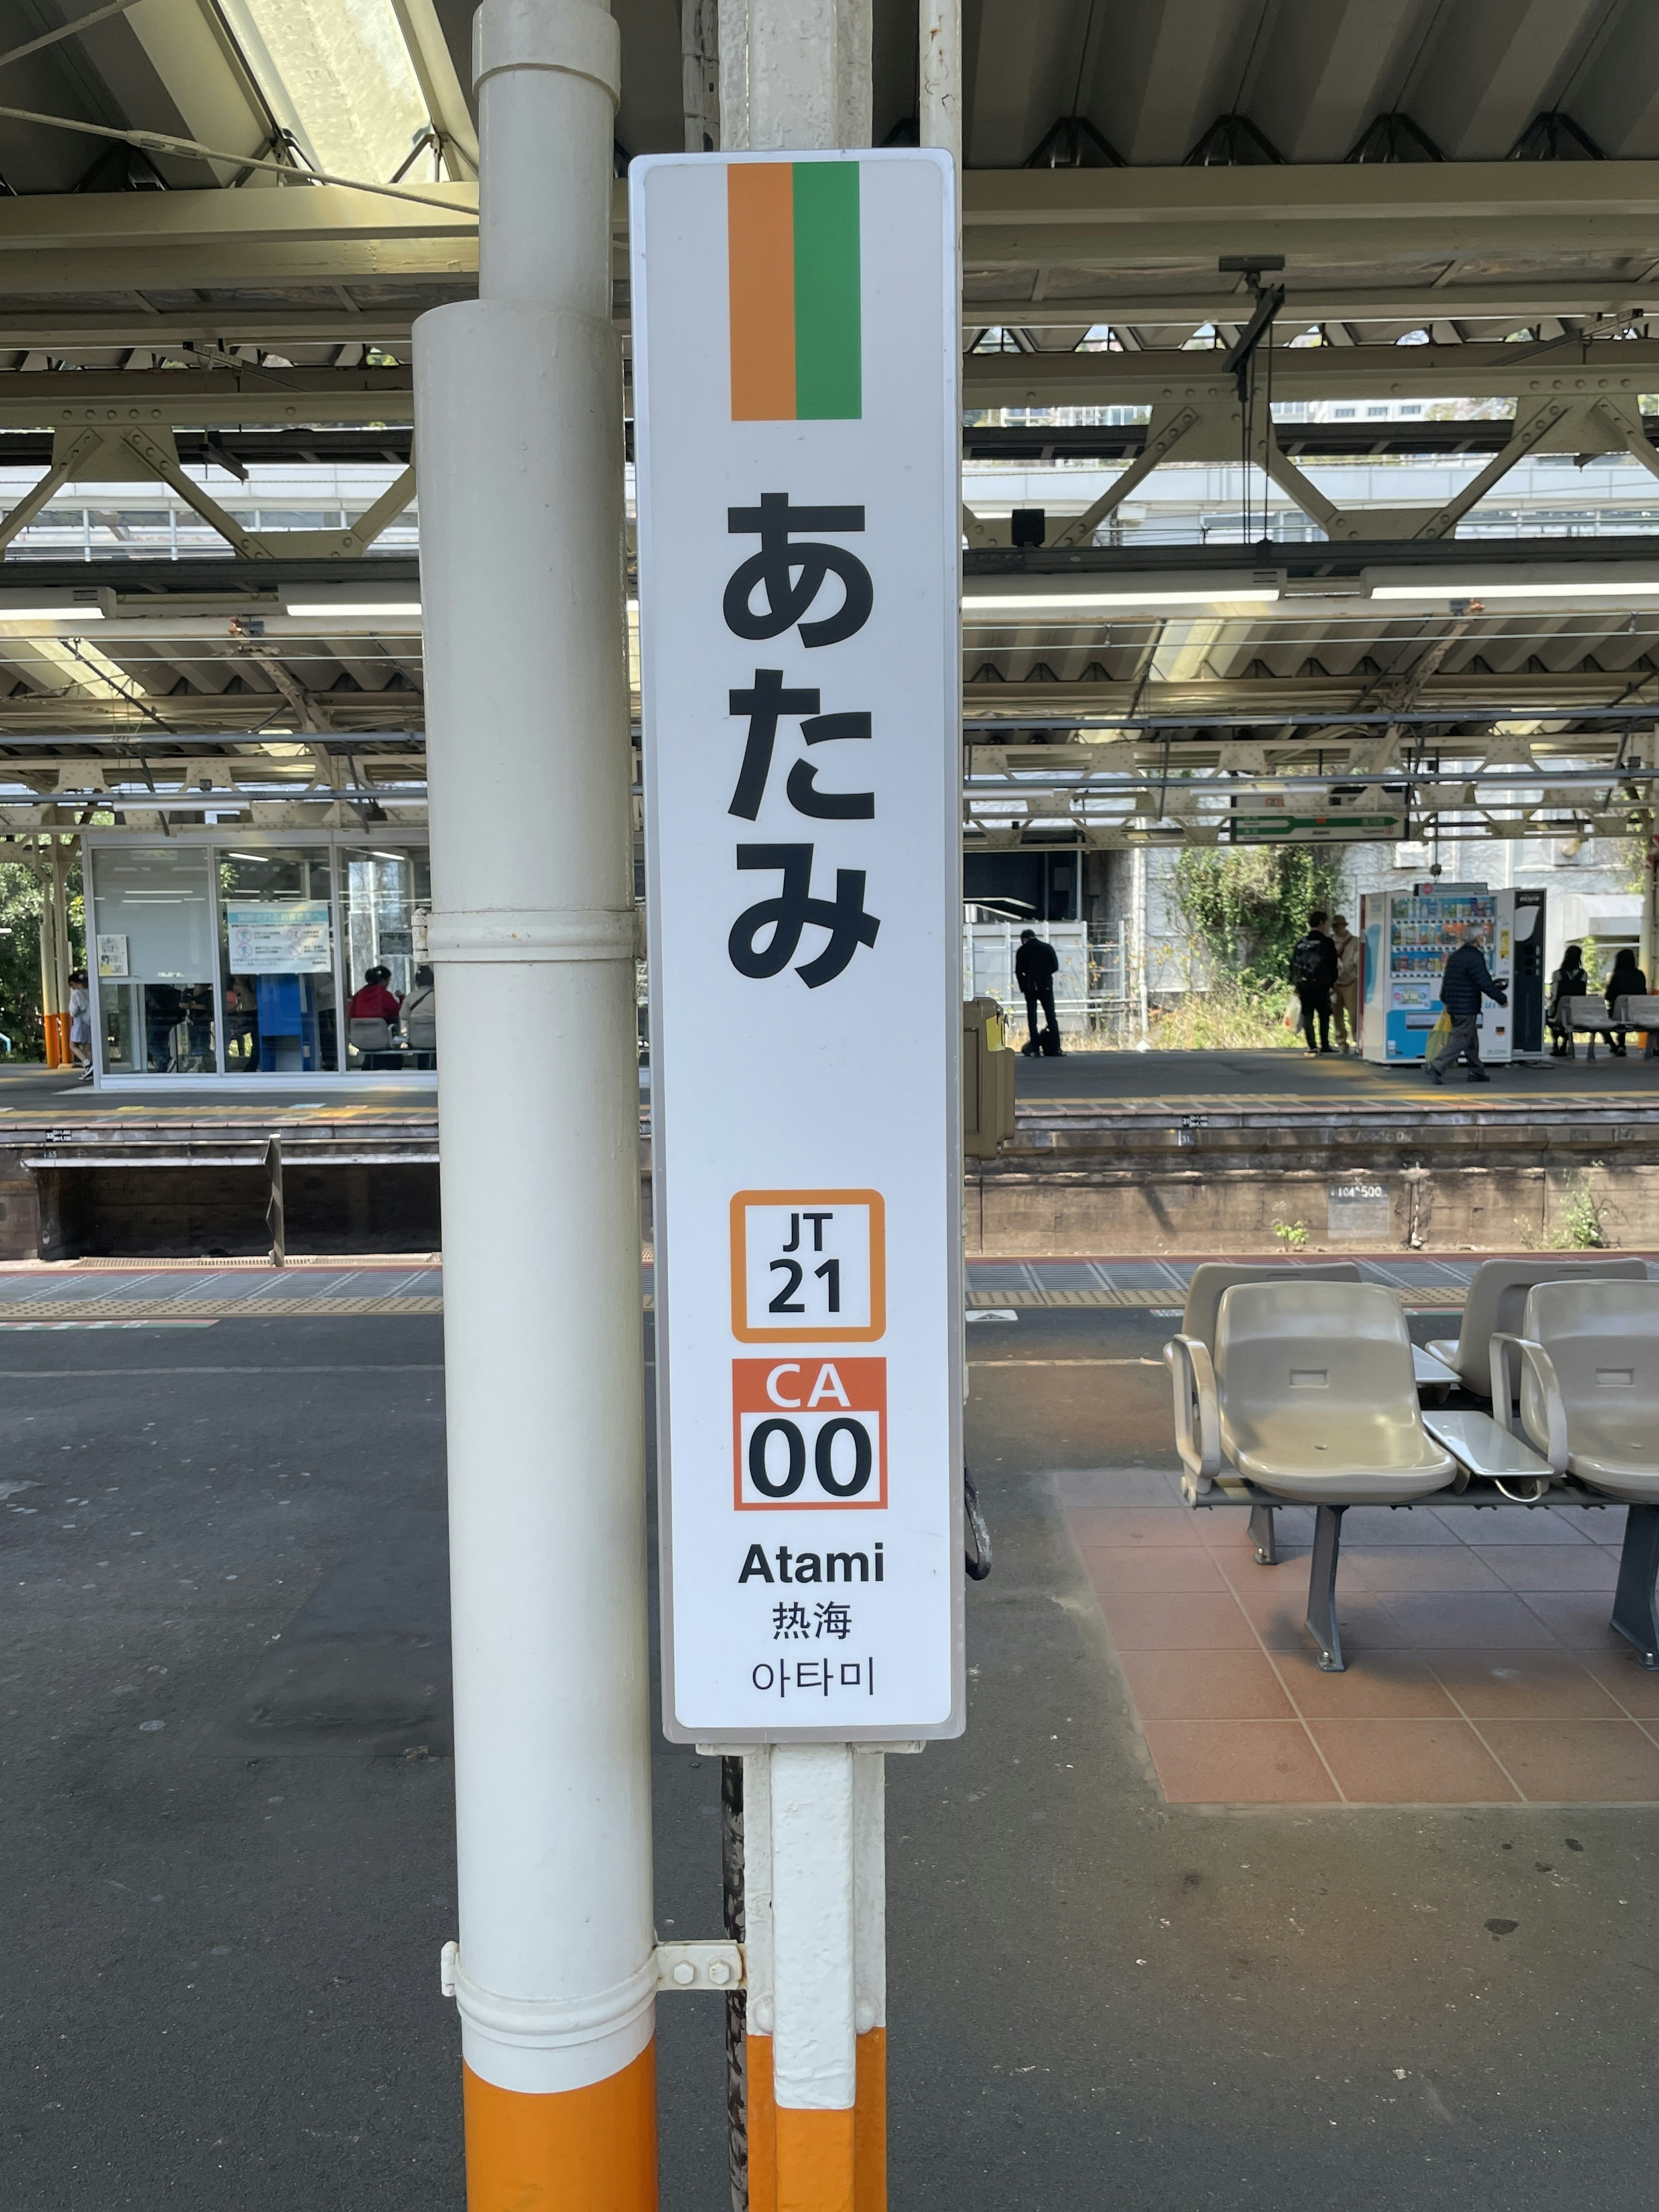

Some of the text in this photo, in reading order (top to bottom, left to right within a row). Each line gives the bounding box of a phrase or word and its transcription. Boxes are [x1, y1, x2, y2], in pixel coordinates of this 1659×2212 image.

[723, 493, 880, 988] あたみ
[783, 1213, 833, 1252] JT
[769, 1259, 840, 1313] 21
[767, 1363, 851, 1408] CA
[749, 1418, 872, 1497] 00
[738, 1543, 884, 1583] Atami
[773, 1601, 852, 1640] 热海
[753, 1657, 873, 1698] 아타미
